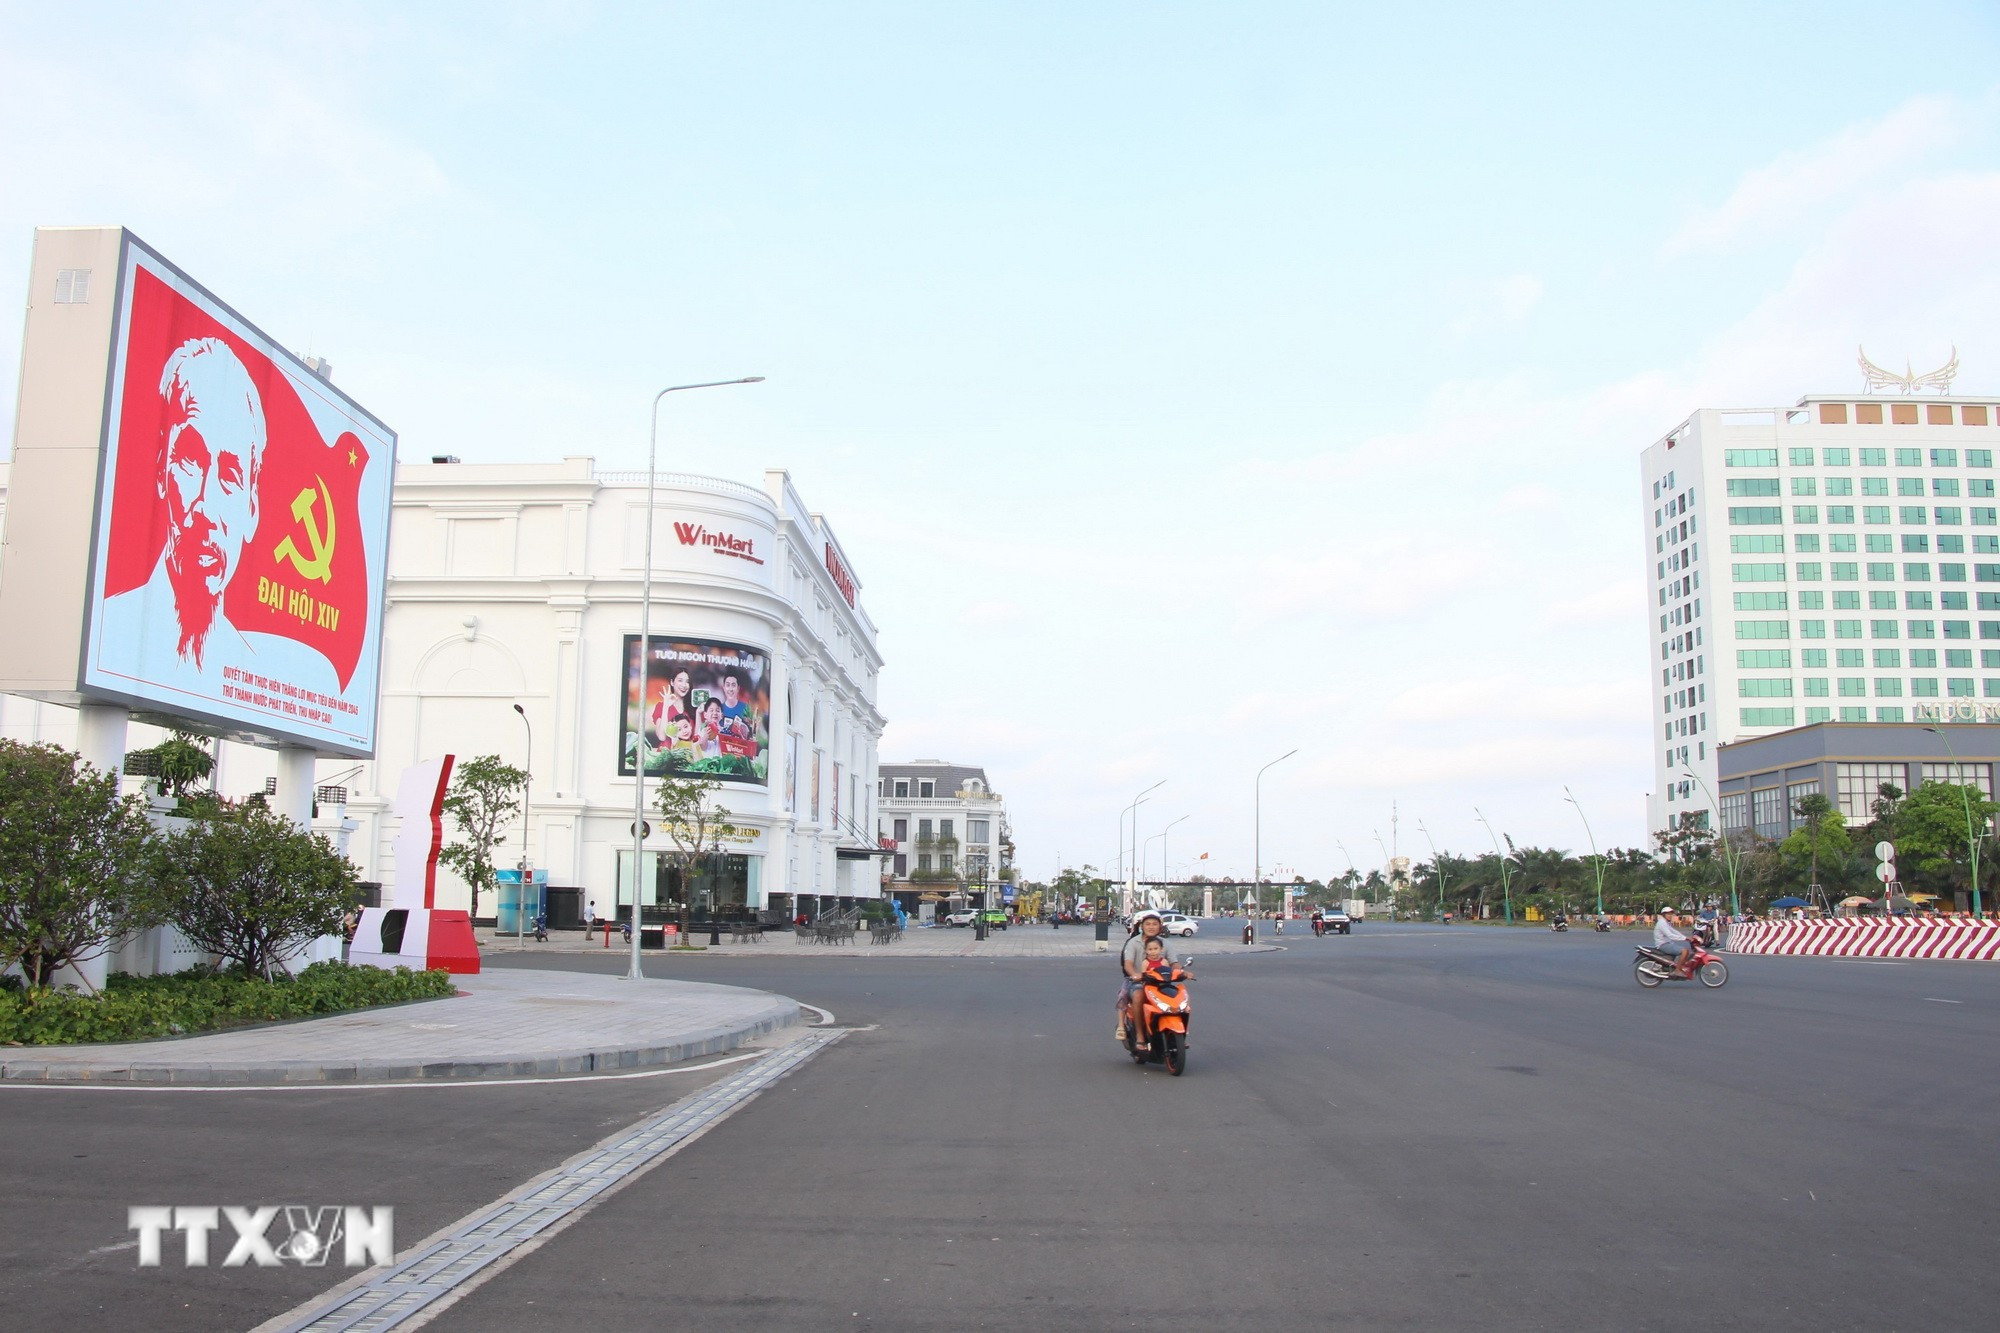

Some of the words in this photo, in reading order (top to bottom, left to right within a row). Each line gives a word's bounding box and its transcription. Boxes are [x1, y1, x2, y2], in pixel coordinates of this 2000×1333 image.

[673, 521, 754, 555] WinMart
[258, 575, 285, 614] ĐẠI
[288, 588, 314, 626] HỘI
[316, 600, 340, 632] XIV
[679, 652, 706, 662] NGON
[222, 682, 234, 698] TRỞ
[234, 687, 253, 703] THÀNH
[252, 692, 268, 708] NƯỚC
[268, 696, 282, 711] PHÁT
[298, 705, 308, 718] THU
[308, 708, 322, 723] NHẬP
[223, 665, 241, 682] QUYẾT
[242, 669, 254, 686] TÂM
[254, 675, 268, 691] THỰC
[268, 678, 281, 694] HIỆN
[281, 682, 298, 698] THẮNG
[306, 690, 317, 705] MỤC
[317, 693, 328, 707] TIÊU
[348, 703, 359, 716] 2045
